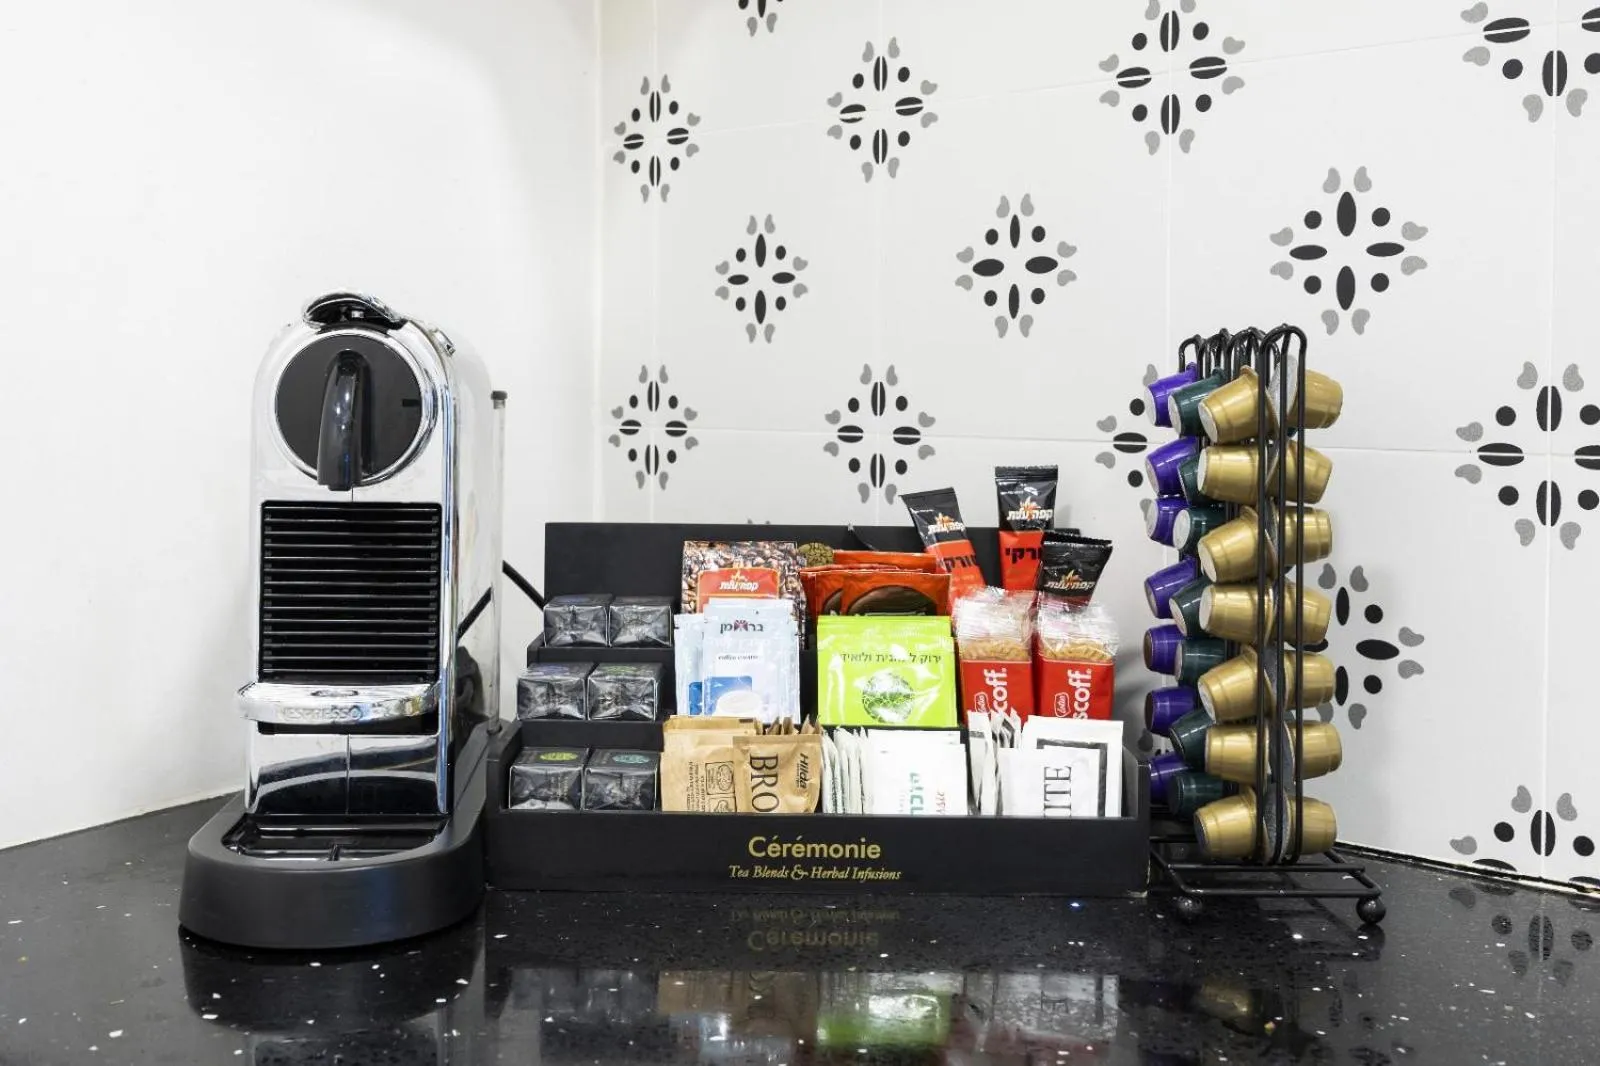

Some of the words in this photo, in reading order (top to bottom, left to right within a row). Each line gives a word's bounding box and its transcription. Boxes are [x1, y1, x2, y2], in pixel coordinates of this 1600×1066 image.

[1044, 766, 1072, 817] ITE
[748, 835, 882, 859] Cérémonie
[728, 865, 749, 878] Tea
[753, 865, 788, 879] Blends
[791, 864, 808, 880] &
[810, 865, 850, 879] Herbal
[852, 867, 902, 883] Infusions
